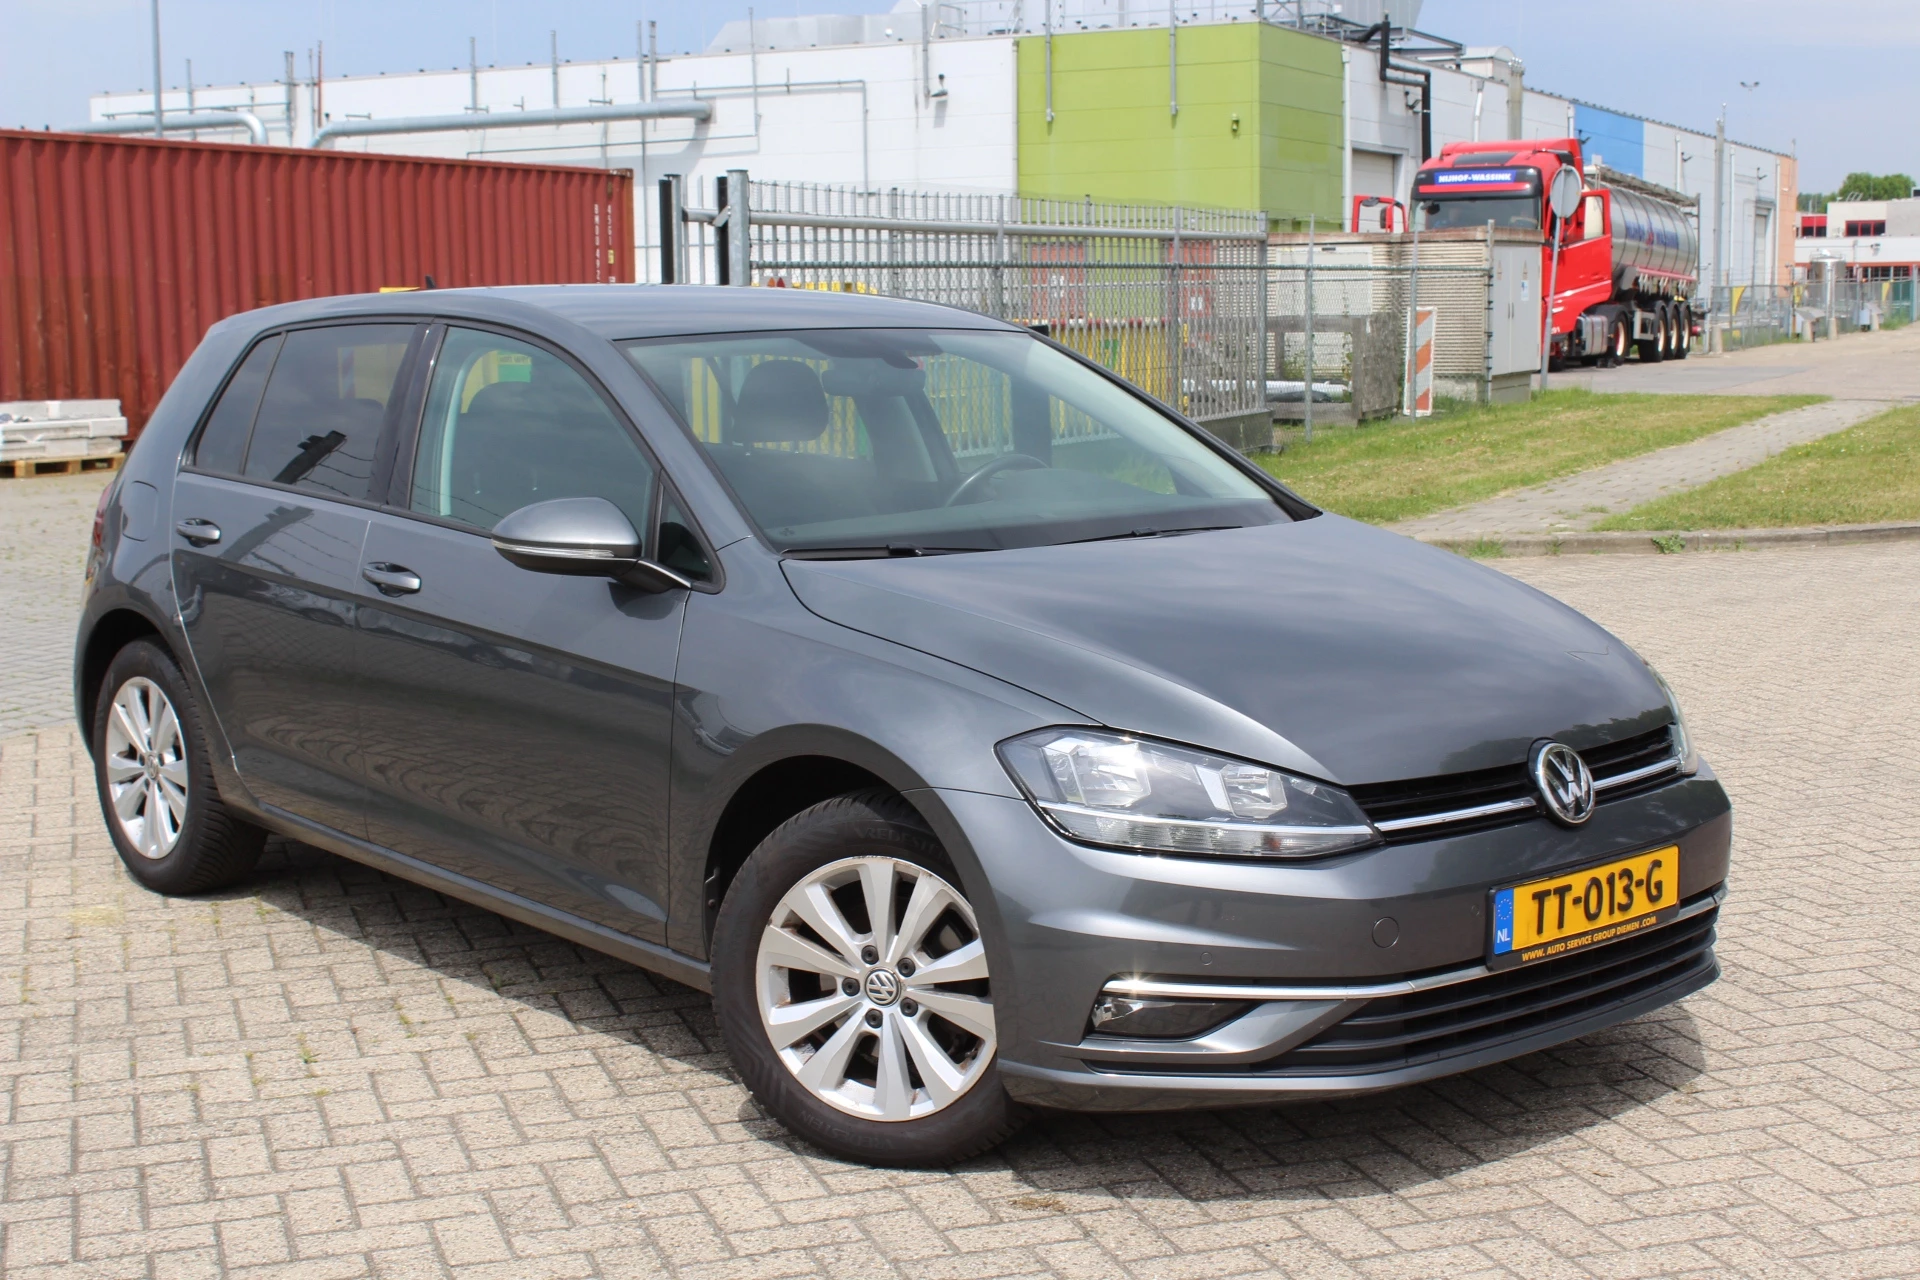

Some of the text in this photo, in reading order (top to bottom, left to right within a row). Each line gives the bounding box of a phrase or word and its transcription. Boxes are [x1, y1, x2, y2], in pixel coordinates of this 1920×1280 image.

[1438, 173, 1511, 183] NIJHOF-WASSINK
[1532, 859, 1663, 936] TT-013-G
[1497, 929, 1510, 943] NL
[1547, 942, 1566, 955] AUTO
[1566, 935, 1592, 950] SERVICE
[1593, 929, 1616, 942] GROUP
[1616, 921, 1640, 935] DIEMEN
